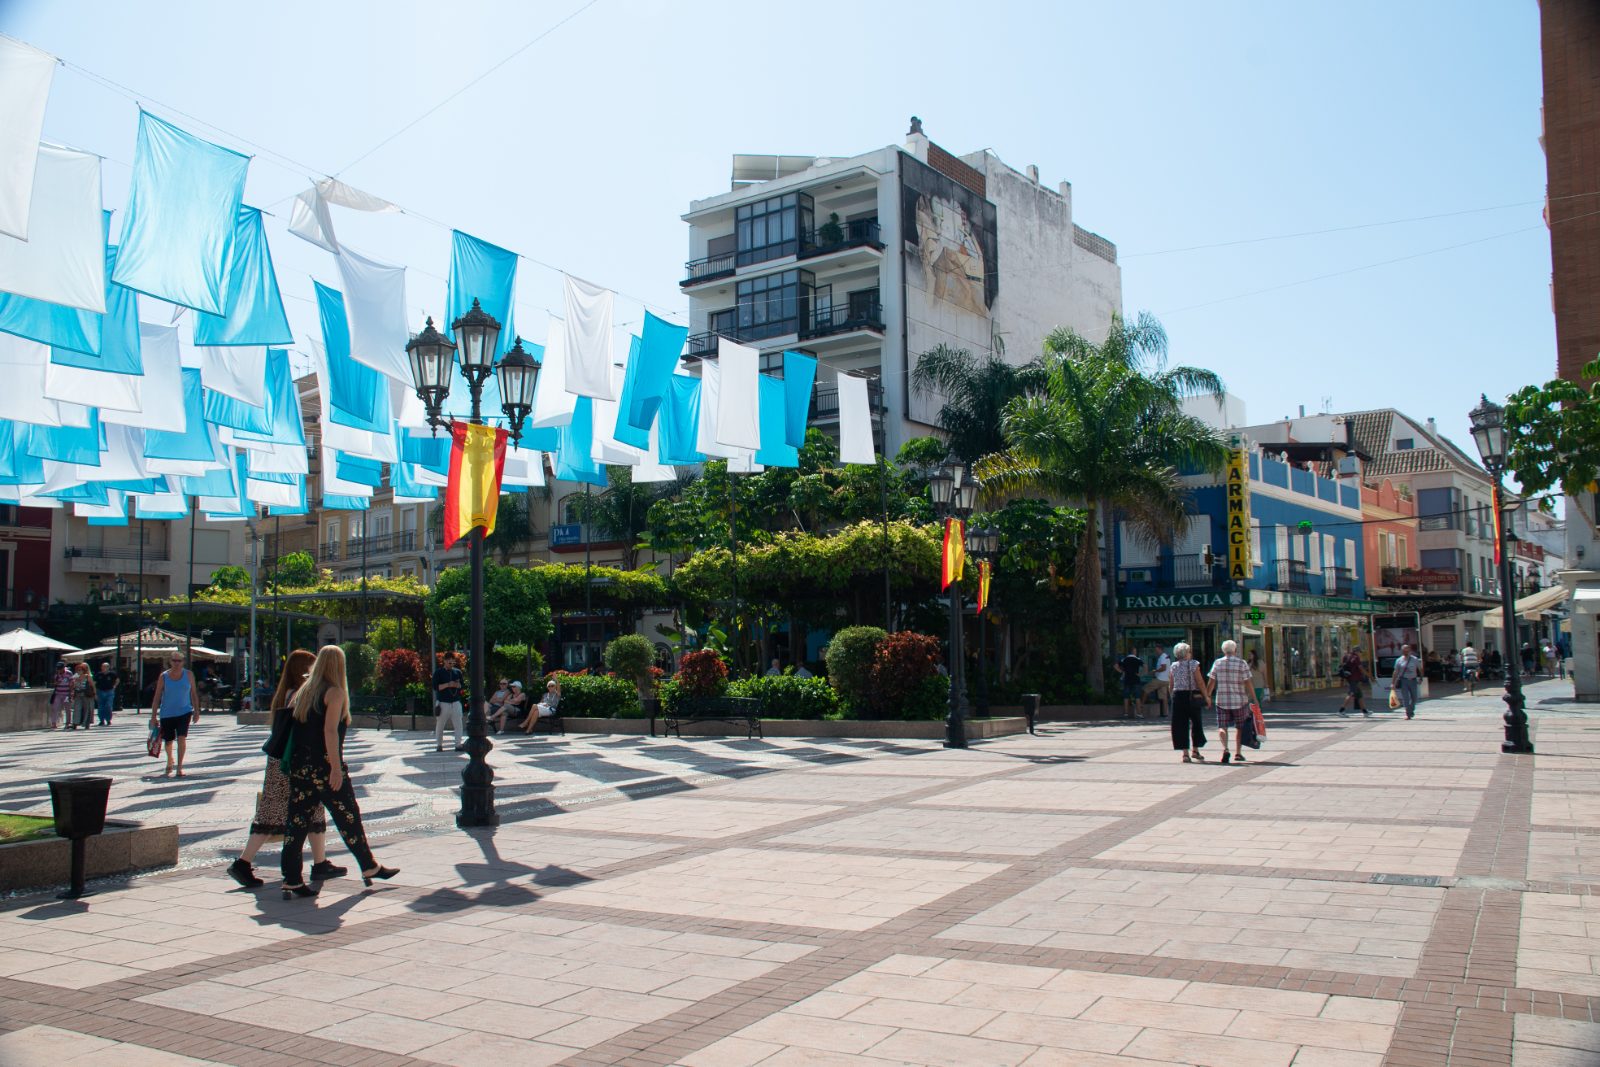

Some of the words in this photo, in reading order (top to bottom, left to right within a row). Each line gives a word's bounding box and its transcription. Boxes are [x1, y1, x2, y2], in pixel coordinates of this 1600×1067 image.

[1229, 450, 1245, 577] FARMACIA
[1126, 593, 1224, 608] FARMACIA
[1136, 611, 1202, 624] FARMACIA
